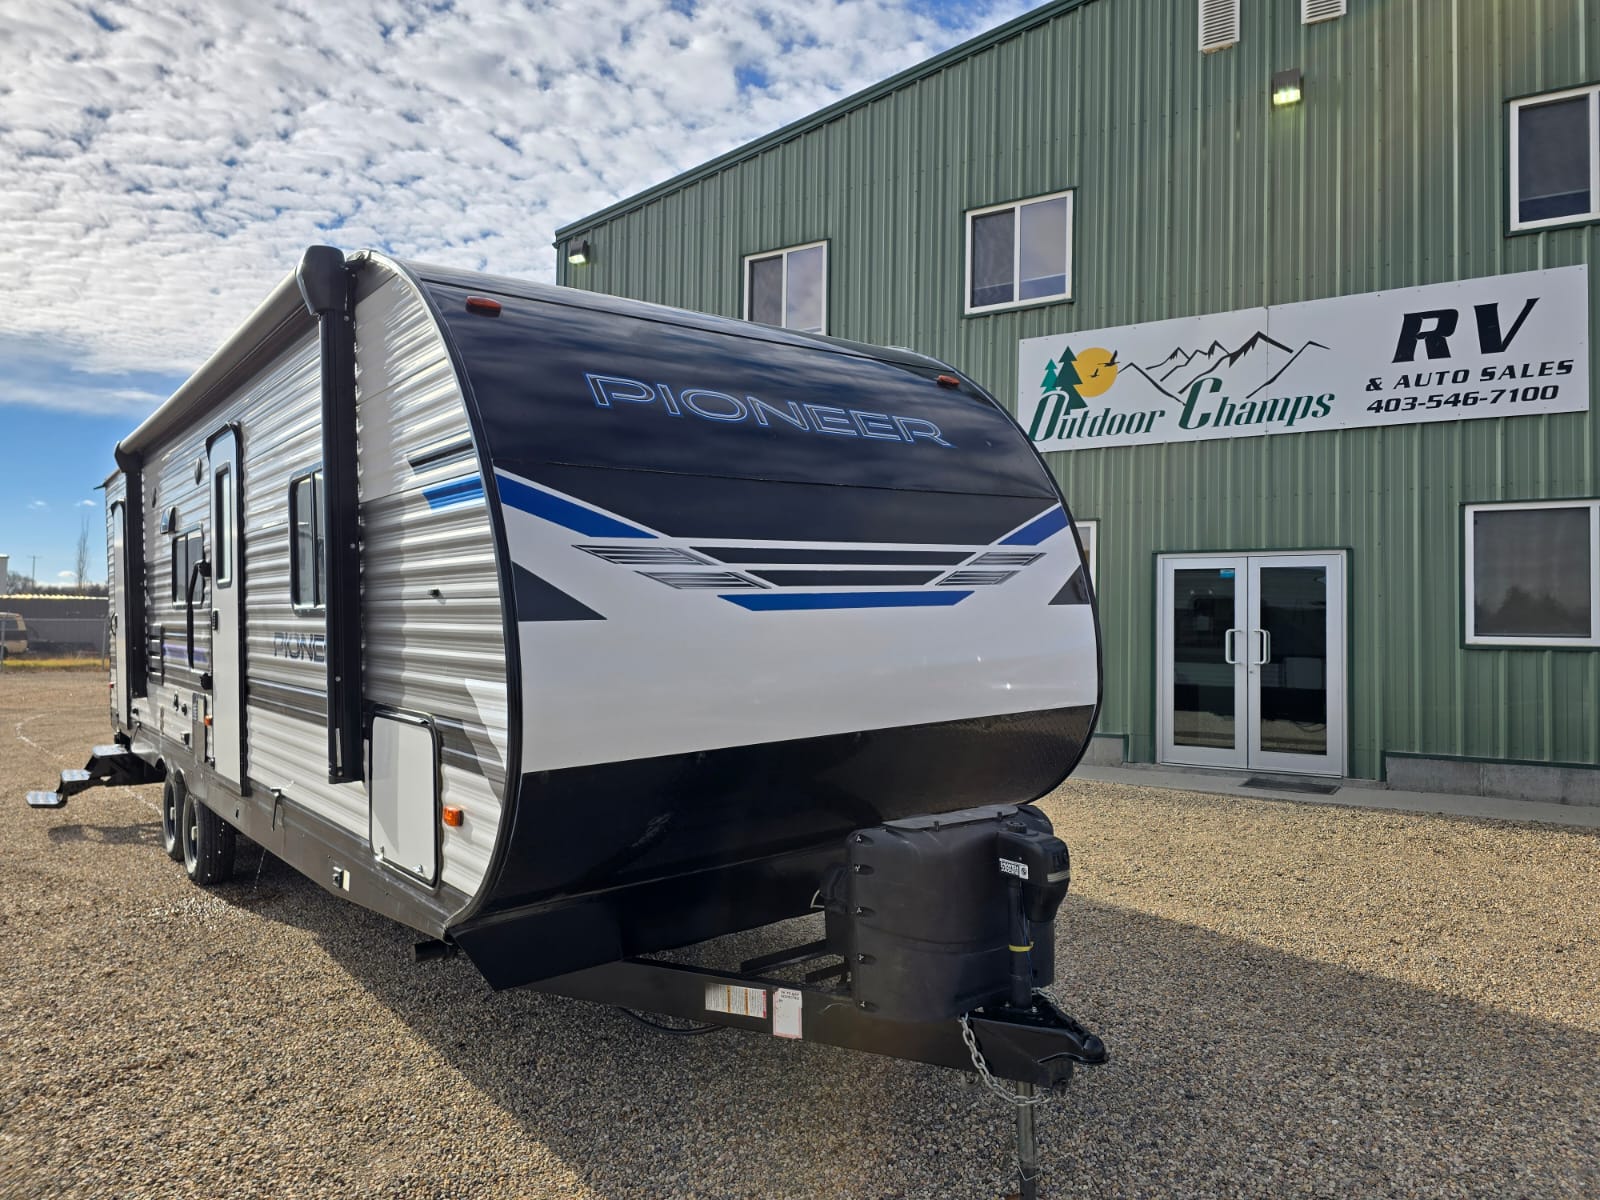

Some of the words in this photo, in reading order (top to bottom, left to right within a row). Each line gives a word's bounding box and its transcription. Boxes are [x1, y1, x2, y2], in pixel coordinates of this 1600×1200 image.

[1391, 297, 1541, 364] RV
[1365, 377, 1384, 392] &
[1393, 369, 1470, 390] AUTO
[1479, 359, 1575, 382] SALES
[1366, 385, 1559, 413] 403-546-7100
[584, 372, 956, 448] PIONEER
[1029, 390, 1165, 442] Outdoor
[1178, 377, 1335, 430] Champs
[273, 631, 326, 663] PIONE
